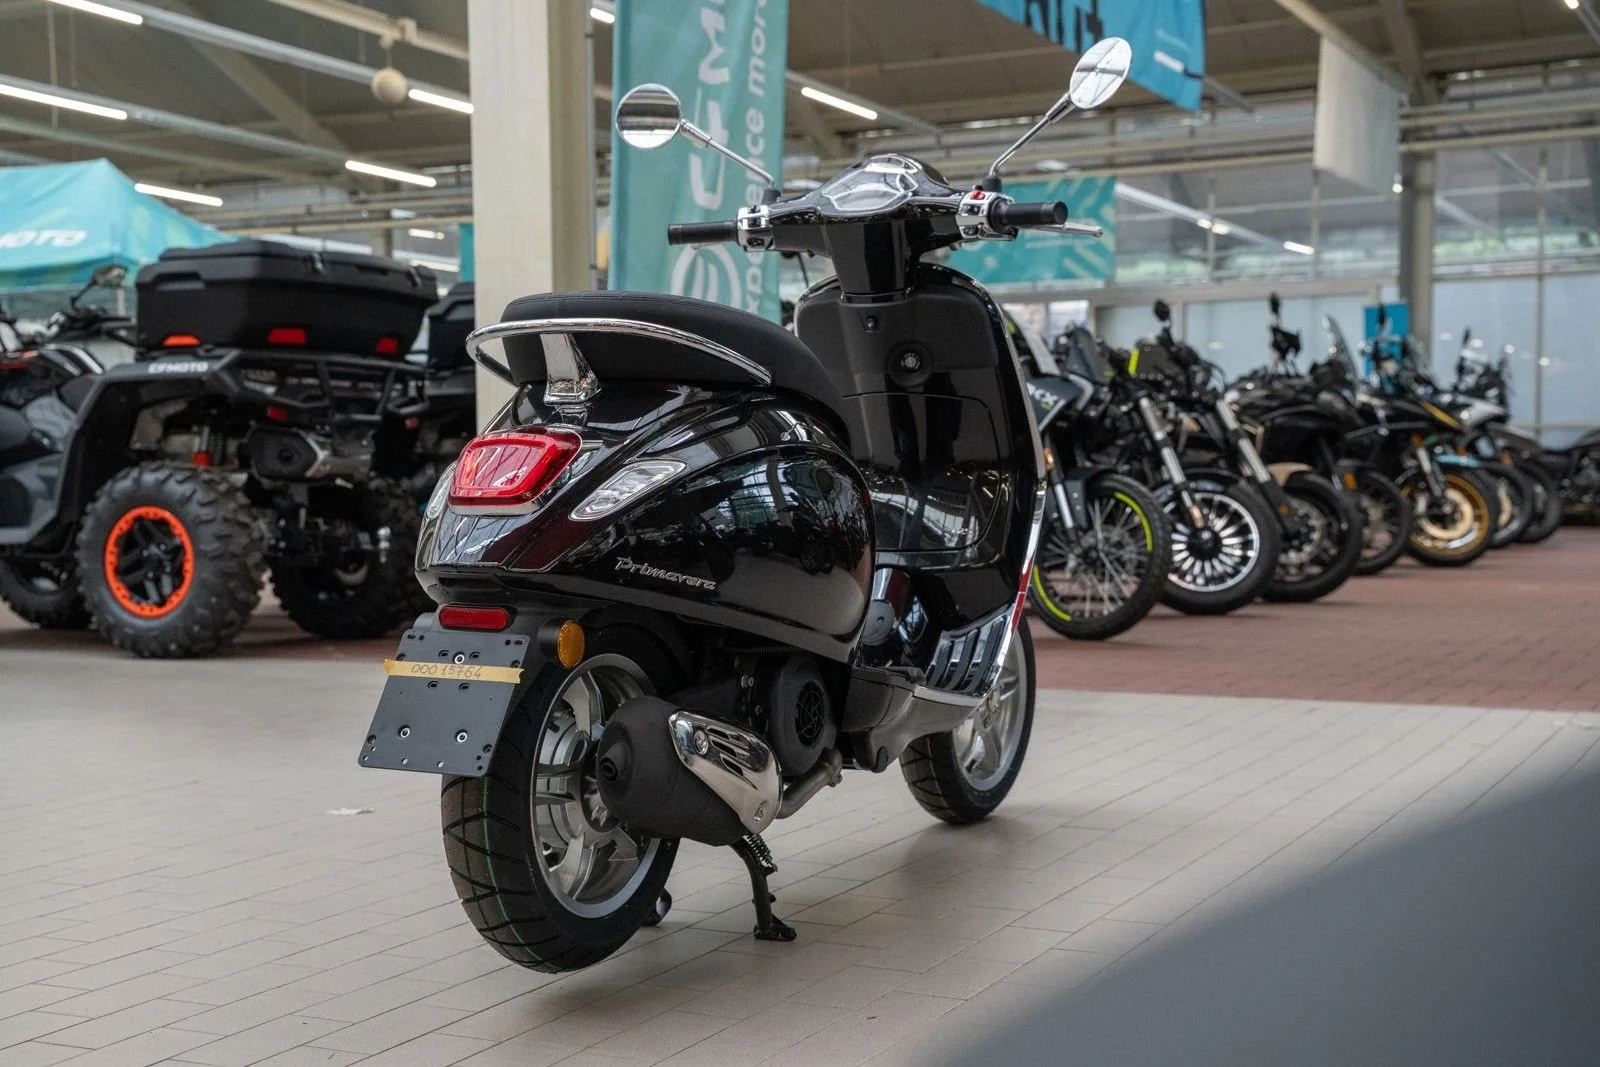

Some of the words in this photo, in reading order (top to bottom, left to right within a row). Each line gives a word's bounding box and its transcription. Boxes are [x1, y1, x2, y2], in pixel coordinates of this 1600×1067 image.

[688, 0, 730, 210] CFM
[147, 361, 209, 374] CFMOTO
[614, 556, 717, 590] Primavera
